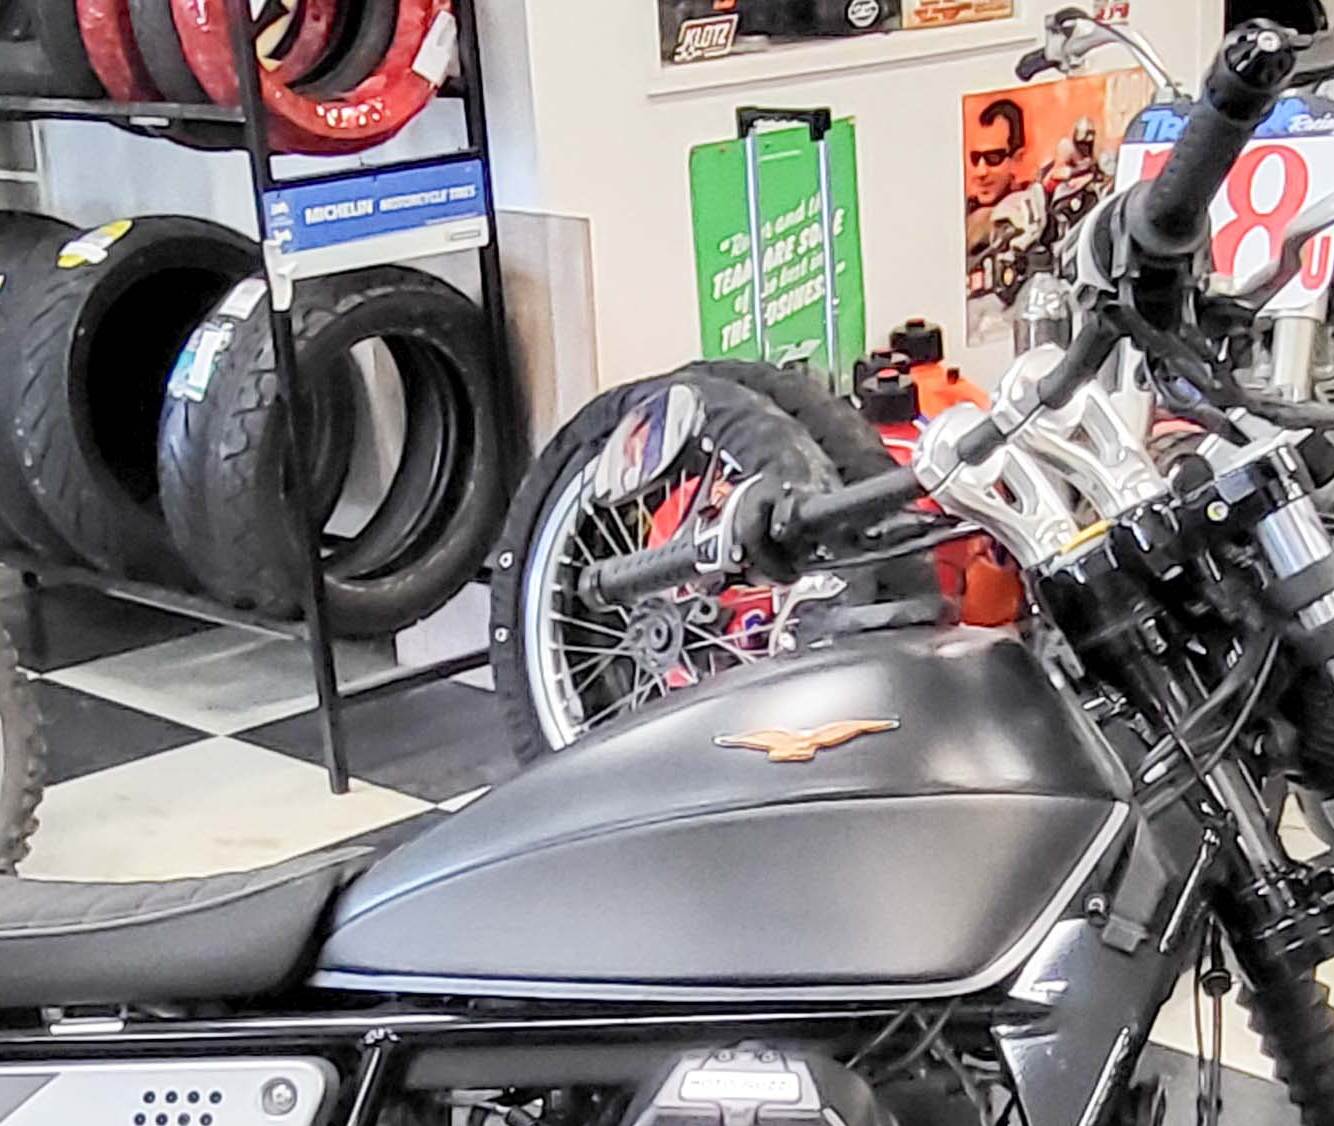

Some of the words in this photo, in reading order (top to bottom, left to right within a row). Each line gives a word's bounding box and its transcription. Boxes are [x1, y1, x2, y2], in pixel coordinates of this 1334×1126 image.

[682, 22, 731, 49] KLOTZ
[305, 199, 374, 225] MICHELIN
[797, 208, 845, 255] SOE
